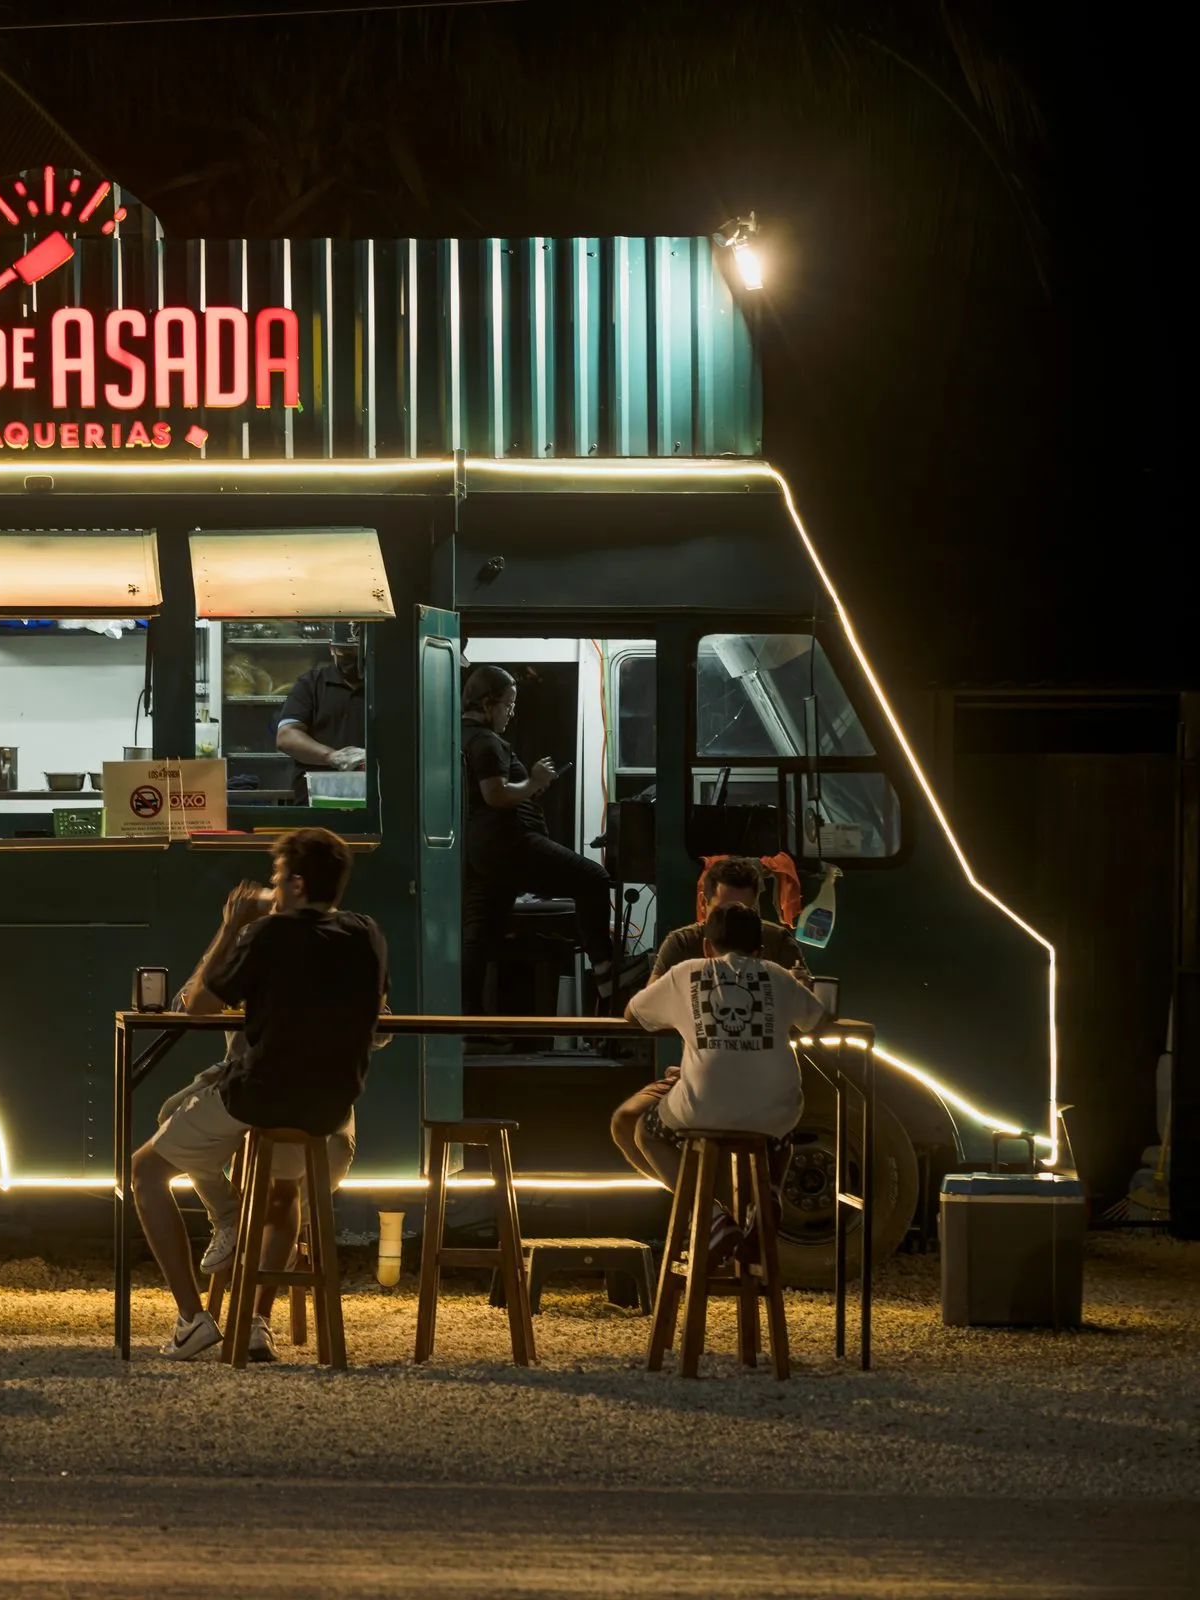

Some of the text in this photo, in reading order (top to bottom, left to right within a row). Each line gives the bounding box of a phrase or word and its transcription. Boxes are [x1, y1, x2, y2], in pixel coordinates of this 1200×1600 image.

[51, 306, 300, 410] ASADA
[695, 1021, 704, 1037] THE
[709, 1039, 760, 1051] OFF THE WALL
